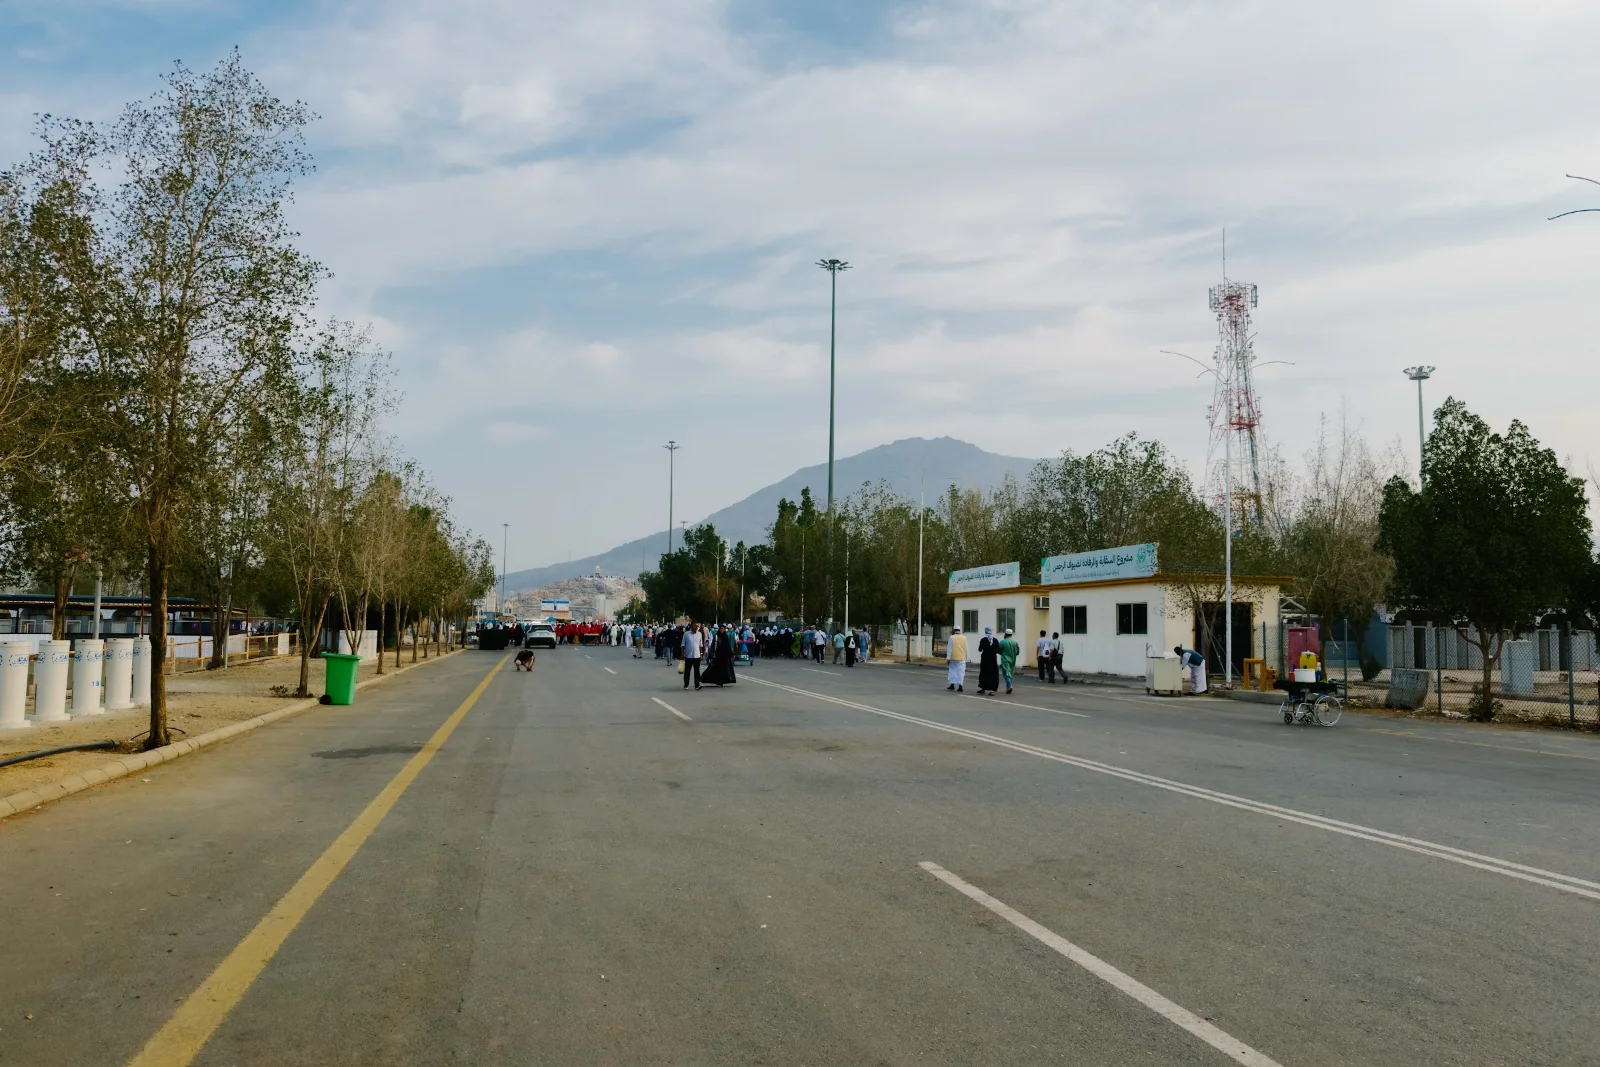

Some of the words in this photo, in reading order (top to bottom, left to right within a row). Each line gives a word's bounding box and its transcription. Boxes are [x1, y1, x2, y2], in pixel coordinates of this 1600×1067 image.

[1067, 558, 1081, 570] لضيوف
[1117, 553, 1133, 566] مشروع
[1052, 560, 1066, 572] الرحمن
